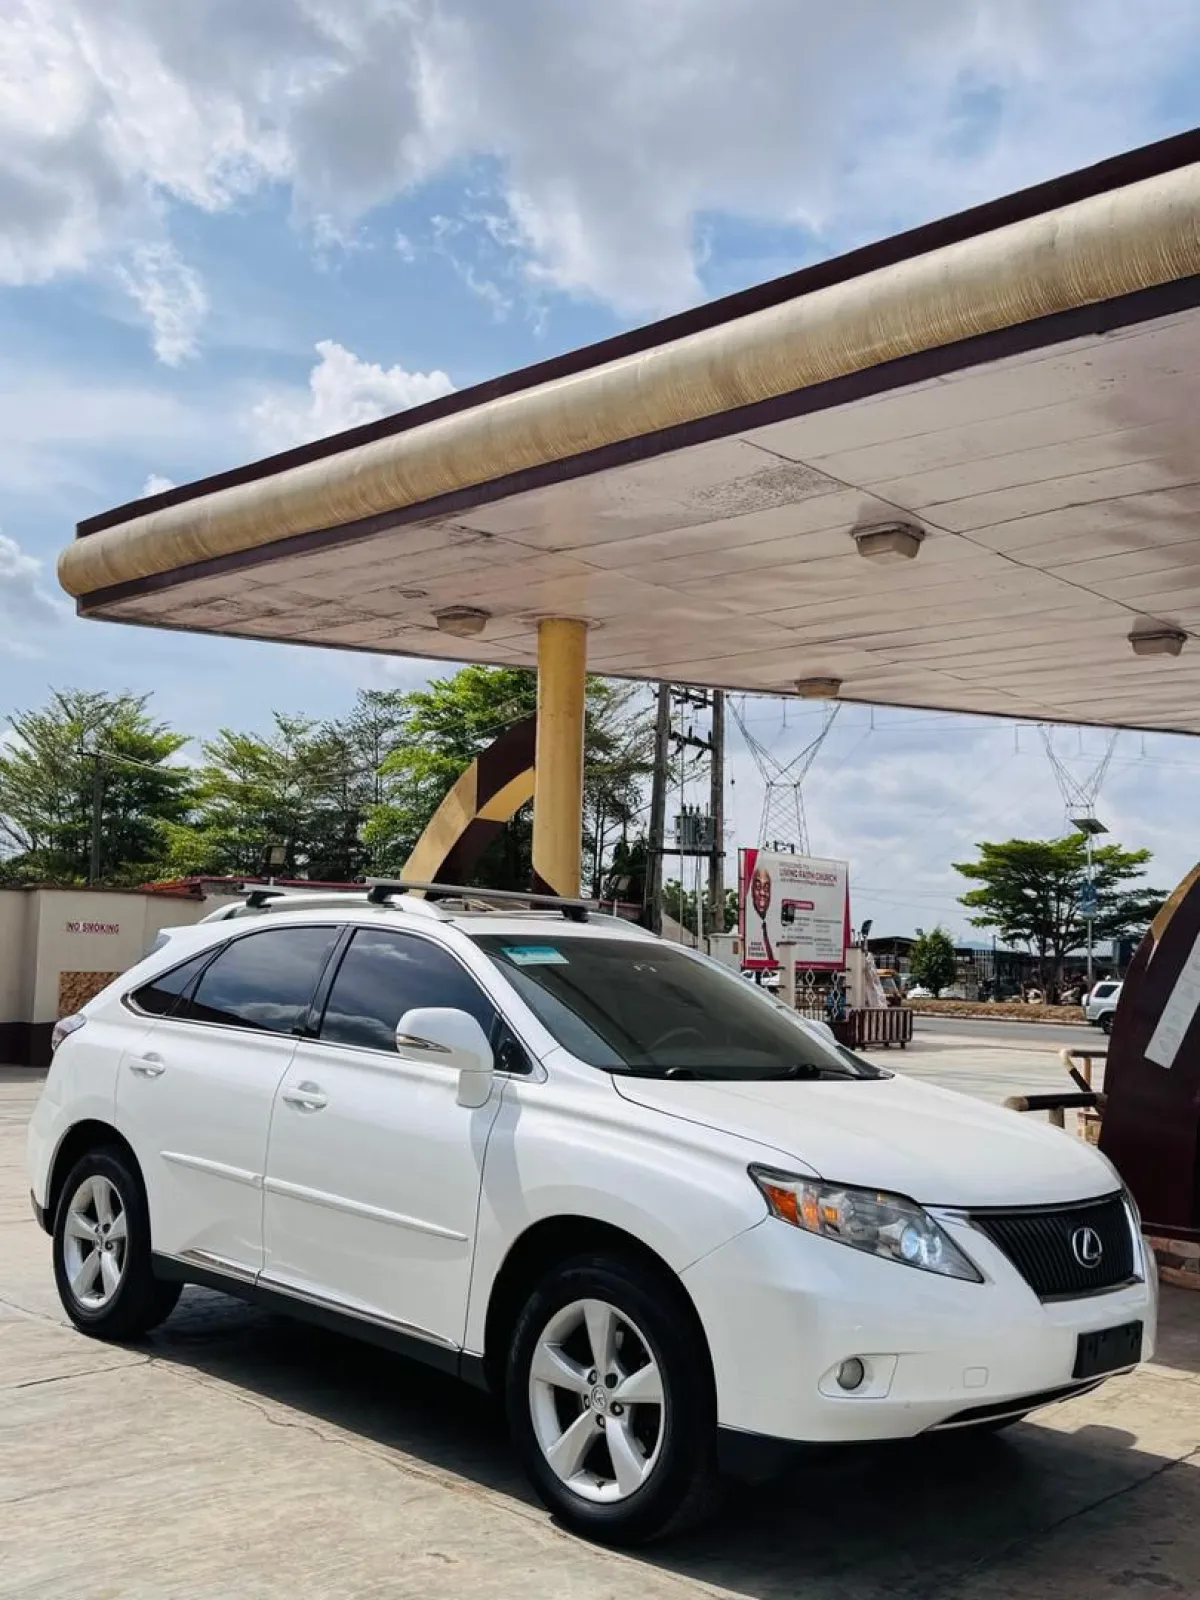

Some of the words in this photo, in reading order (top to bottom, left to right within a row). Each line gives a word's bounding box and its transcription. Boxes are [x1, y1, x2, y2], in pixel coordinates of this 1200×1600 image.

[779, 868, 798, 878] LIVING
[799, 870, 814, 879] FAITH
[816, 872, 837, 882] CHURCH
[67, 922, 80, 933] NO
[82, 922, 120, 934] SMOKING
